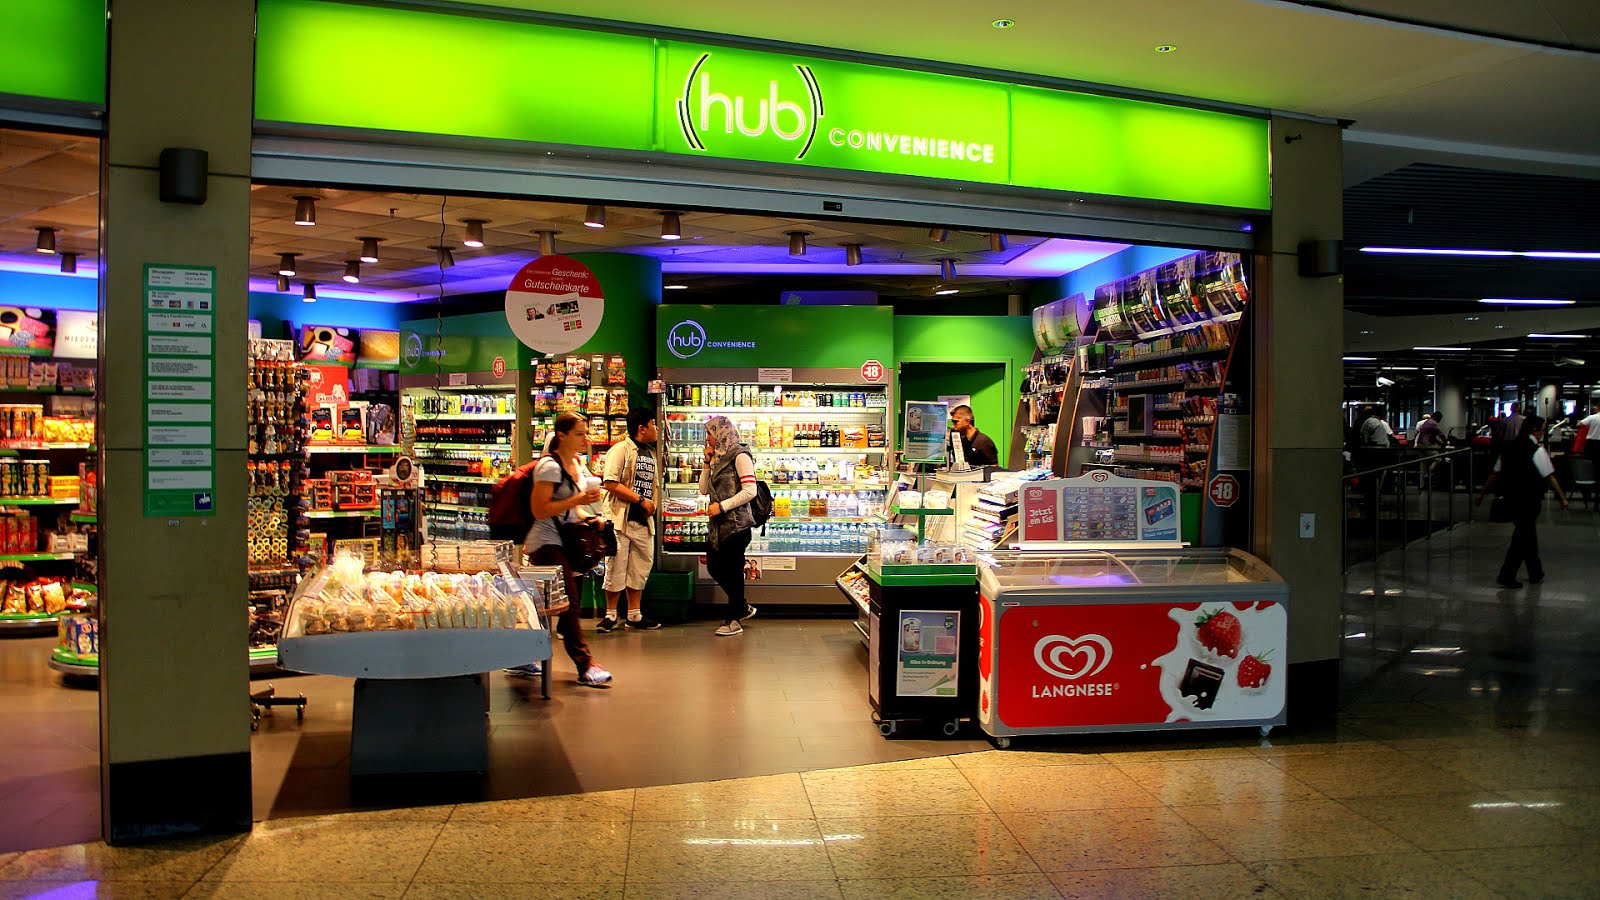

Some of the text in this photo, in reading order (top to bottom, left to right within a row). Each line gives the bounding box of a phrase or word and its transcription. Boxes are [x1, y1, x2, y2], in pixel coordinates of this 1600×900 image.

[700, 71, 994, 164] hub CONVENIENCE
[524, 278, 590, 293] Gutscheinkarte
[673, 331, 701, 347] hub
[1029, 507, 1053, 517] Jetzt
[1032, 683, 1113, 698] LANGNESE
